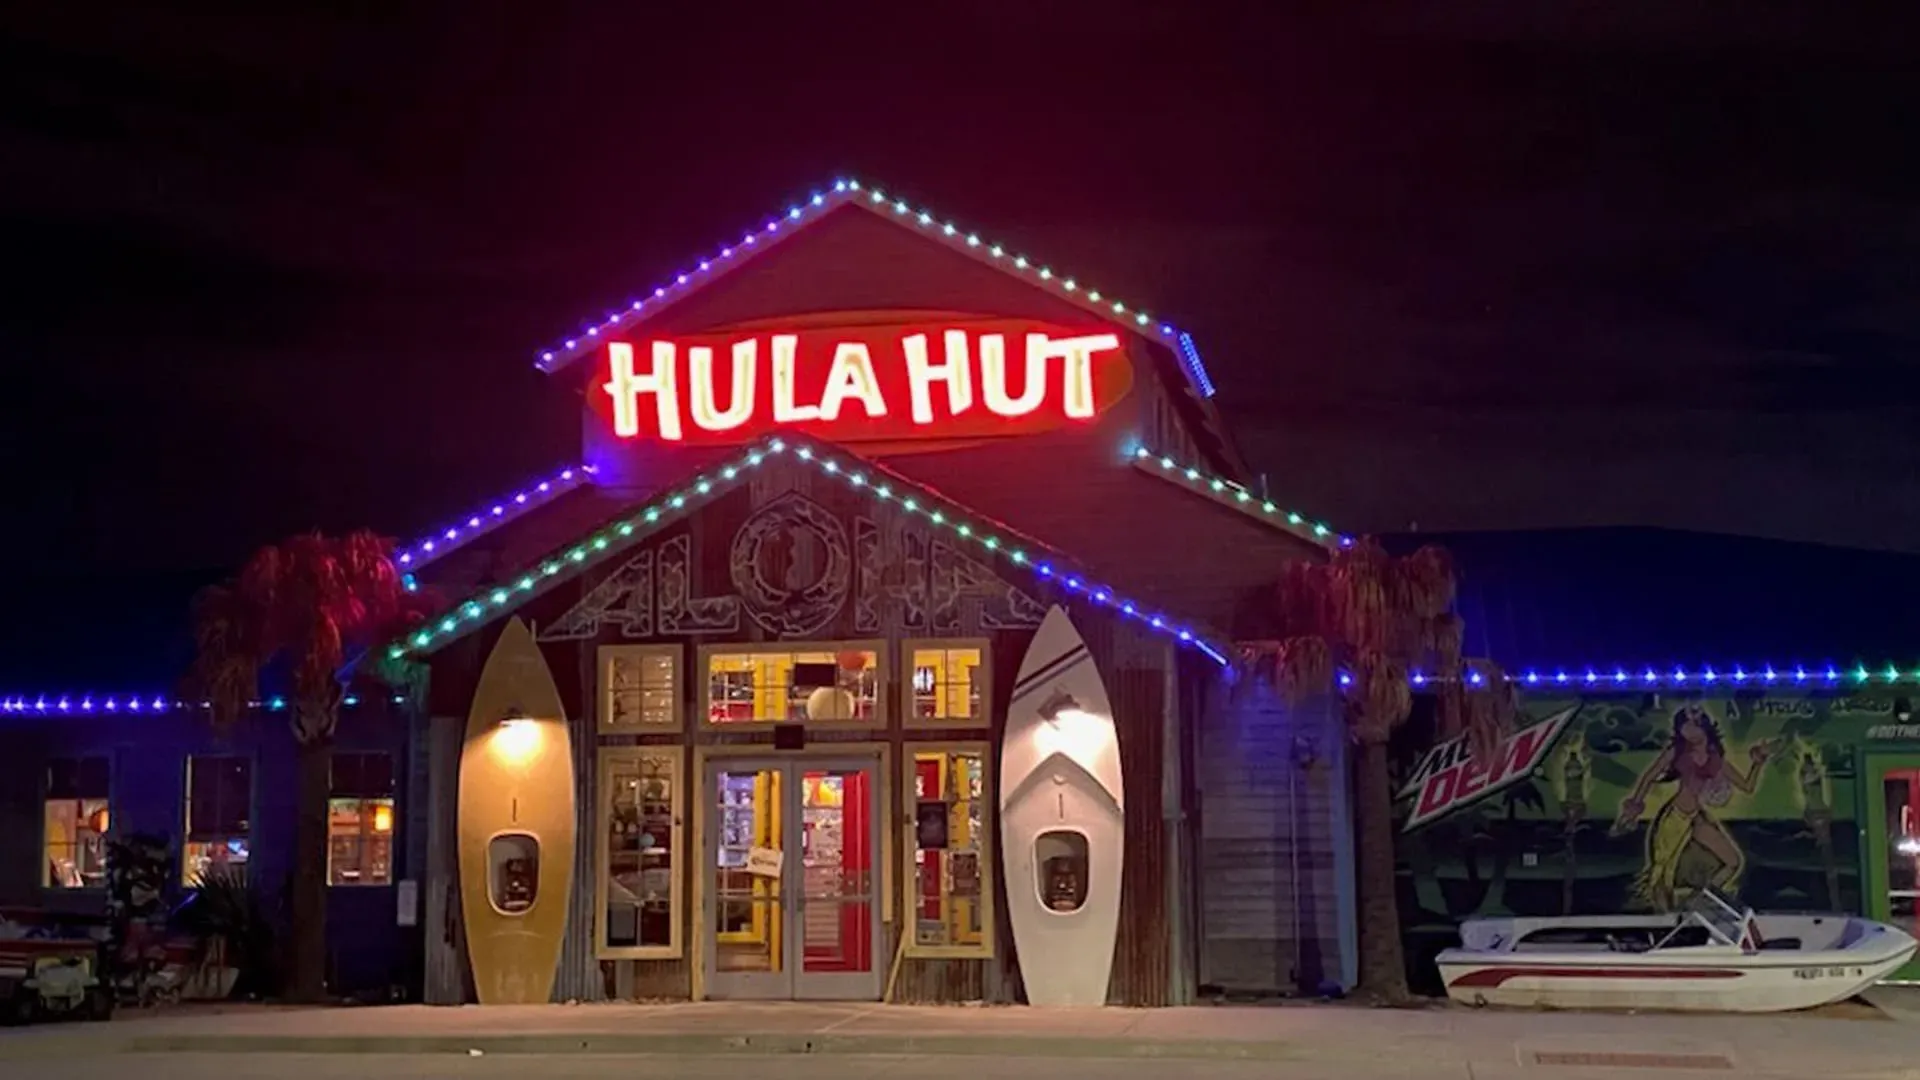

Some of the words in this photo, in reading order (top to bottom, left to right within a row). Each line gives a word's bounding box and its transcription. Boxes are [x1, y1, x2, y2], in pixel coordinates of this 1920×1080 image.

[602, 333, 888, 441] HULA
[901, 329, 1120, 425] HUT
[535, 488, 1050, 641] ALOHA
